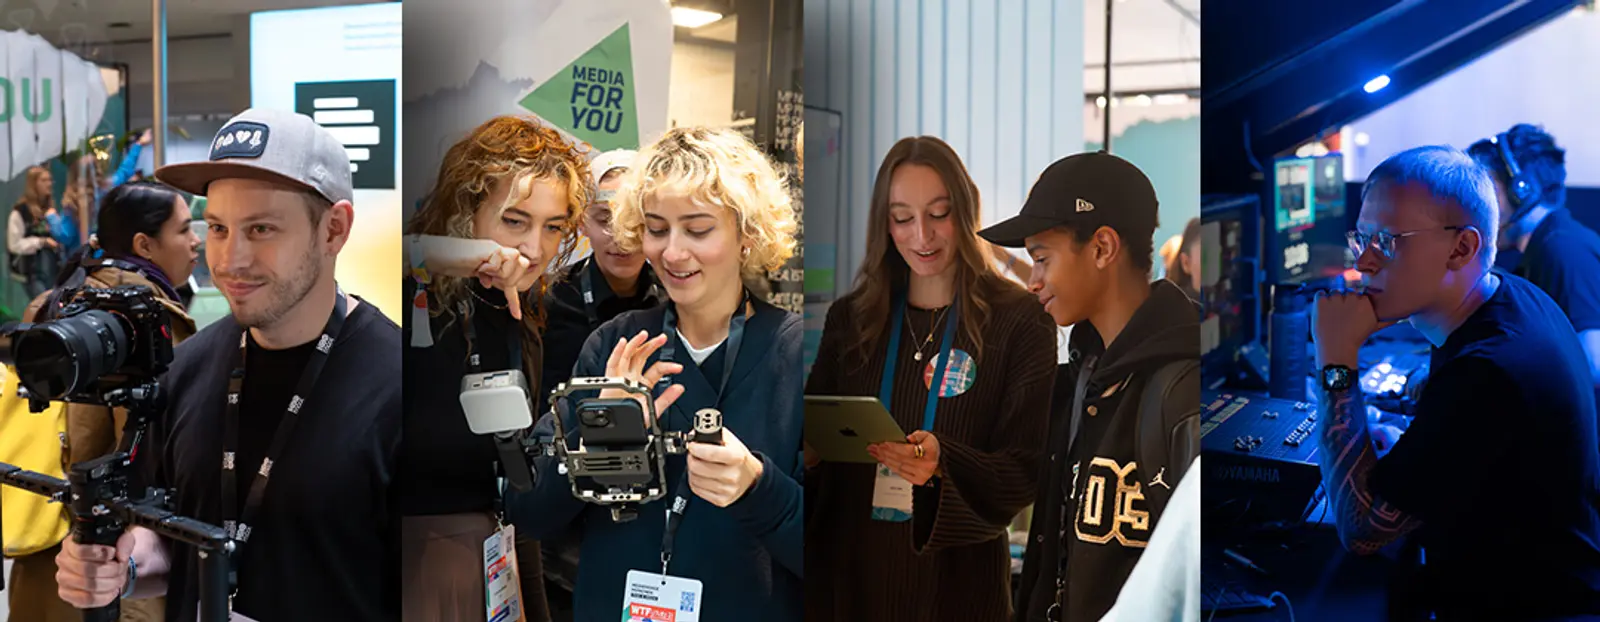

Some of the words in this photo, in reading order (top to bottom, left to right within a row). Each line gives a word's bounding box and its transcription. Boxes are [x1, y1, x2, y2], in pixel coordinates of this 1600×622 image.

[572, 64, 625, 87] MEDIA
[570, 80, 624, 110] FOR
[571, 105, 624, 134] YOU
[1229, 465, 1281, 483] YAMAHA
[630, 604, 652, 619] WTF
